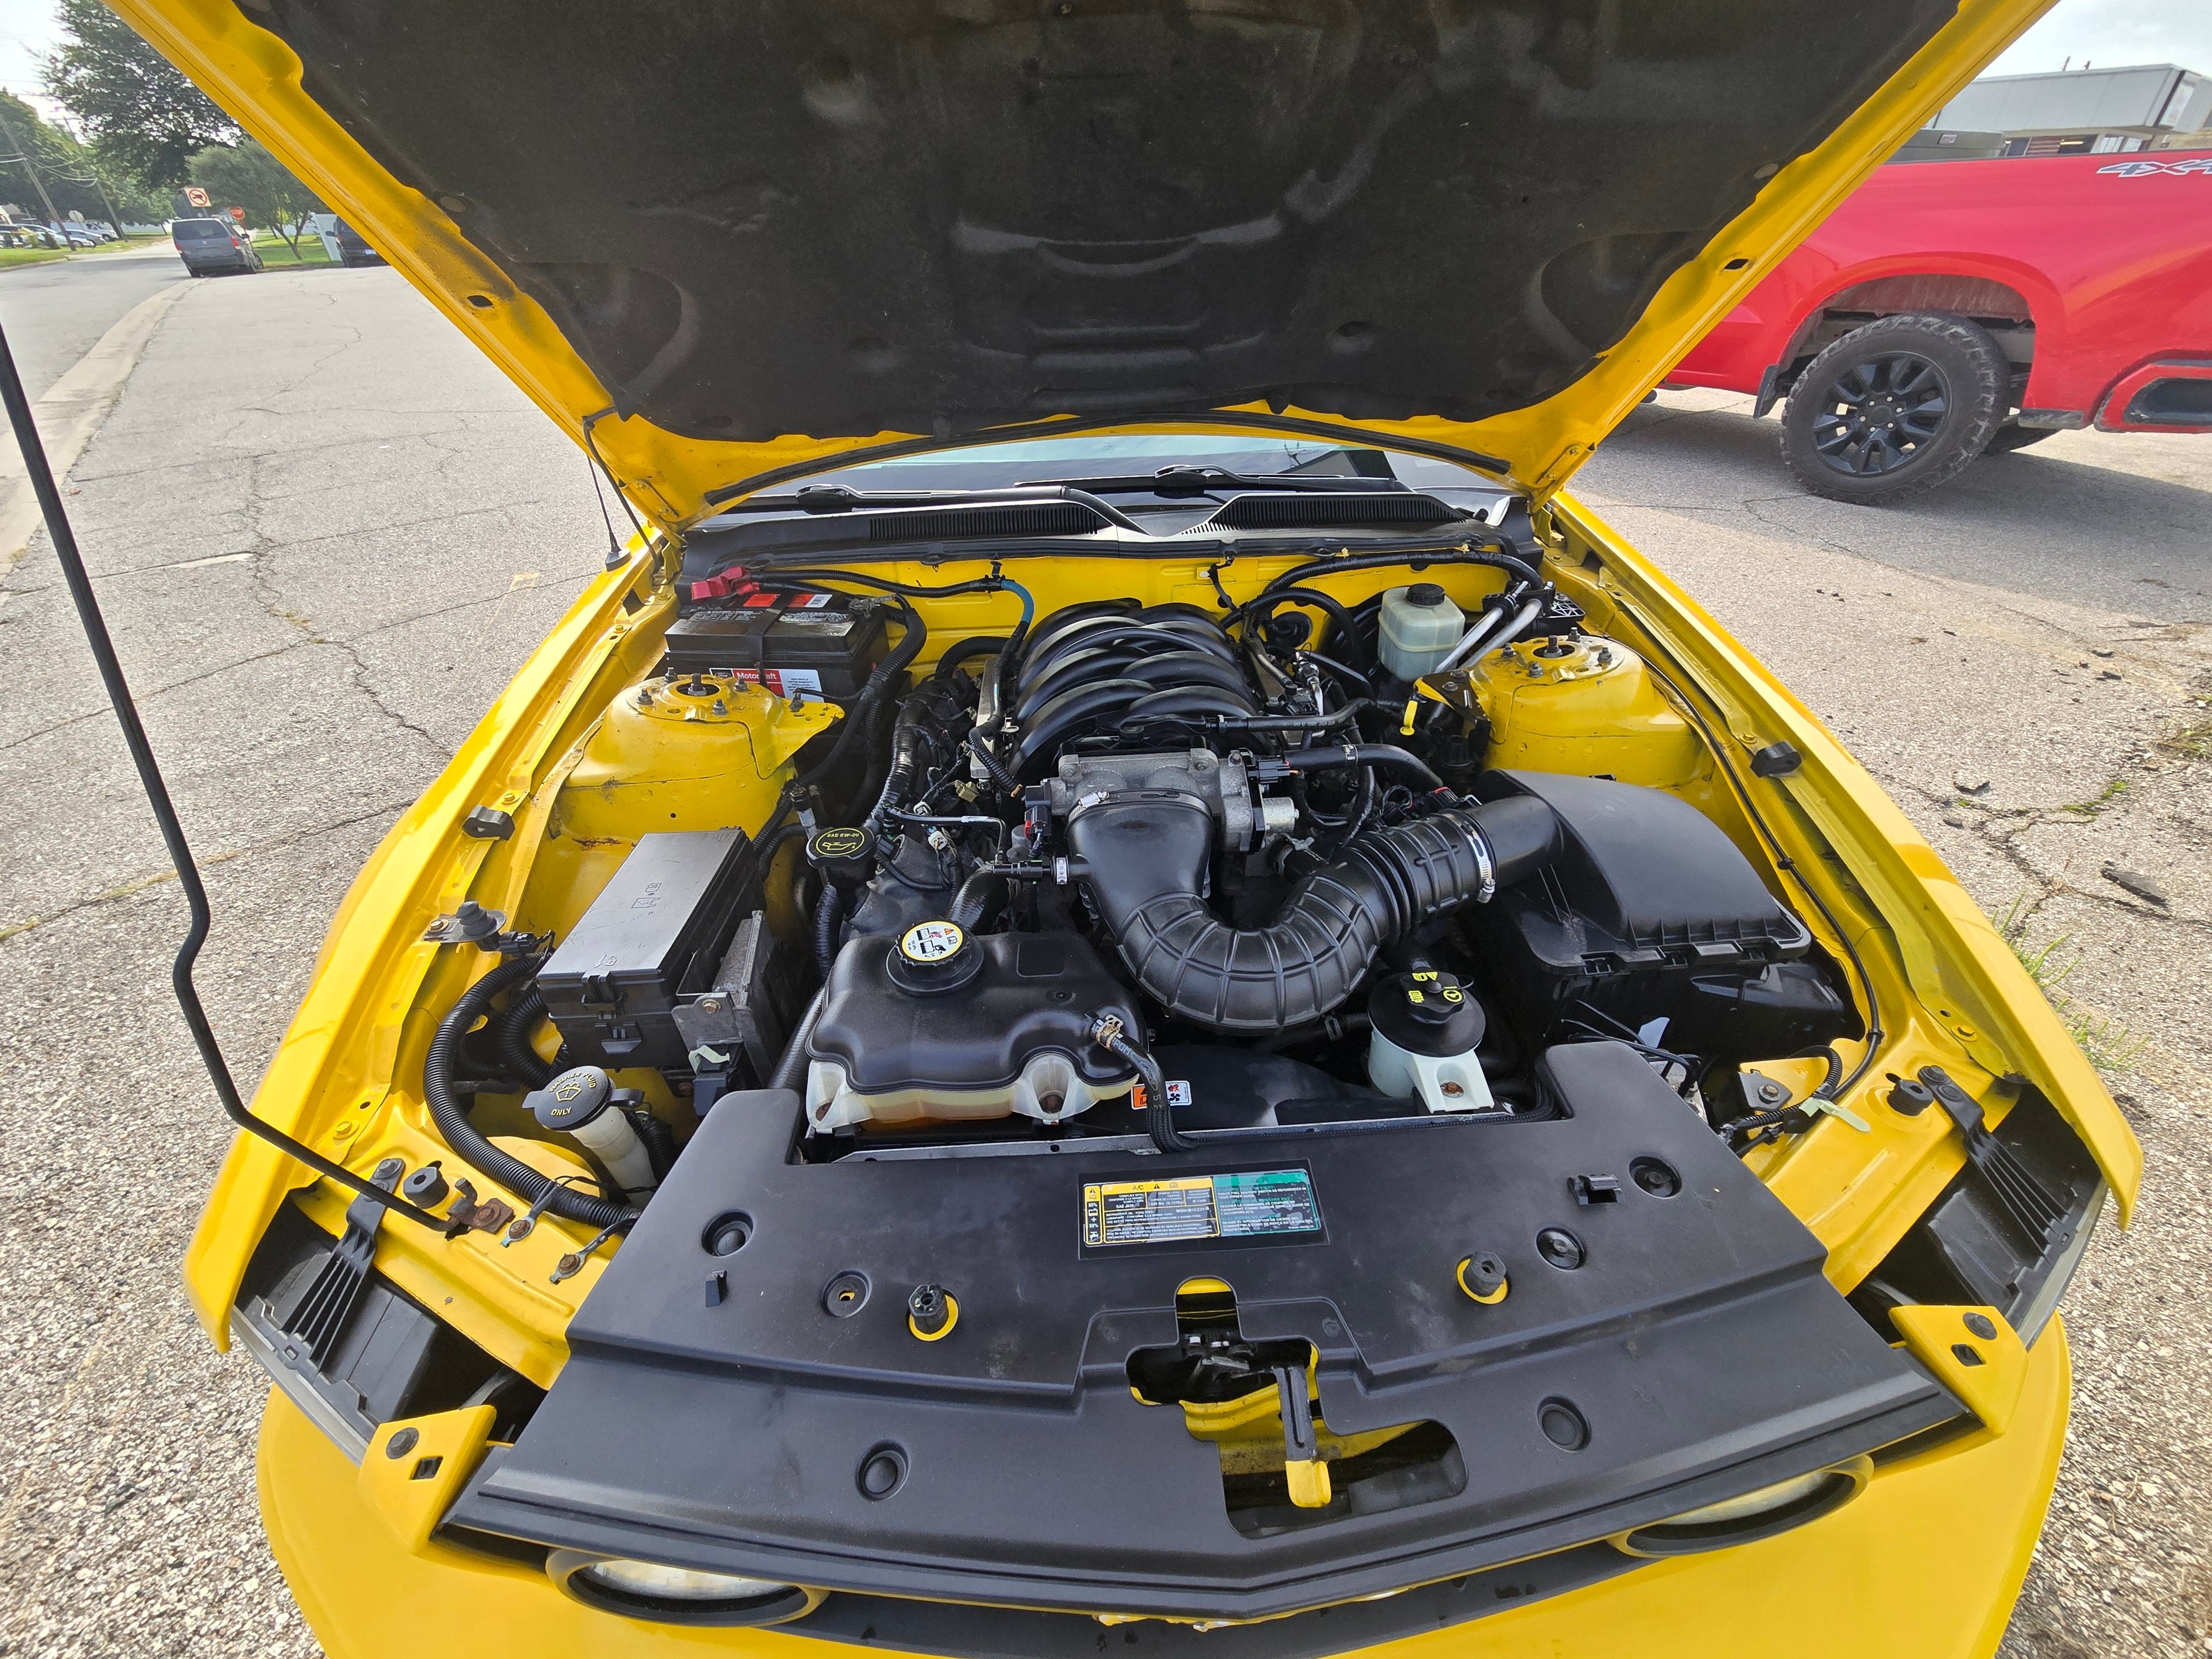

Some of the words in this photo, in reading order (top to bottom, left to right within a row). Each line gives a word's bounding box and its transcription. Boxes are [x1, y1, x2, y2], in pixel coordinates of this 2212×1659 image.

[548, 1072, 582, 1092] WASHER
[583, 1072, 597, 1088] FLUID
[550, 1107, 572, 1116] ONLY
